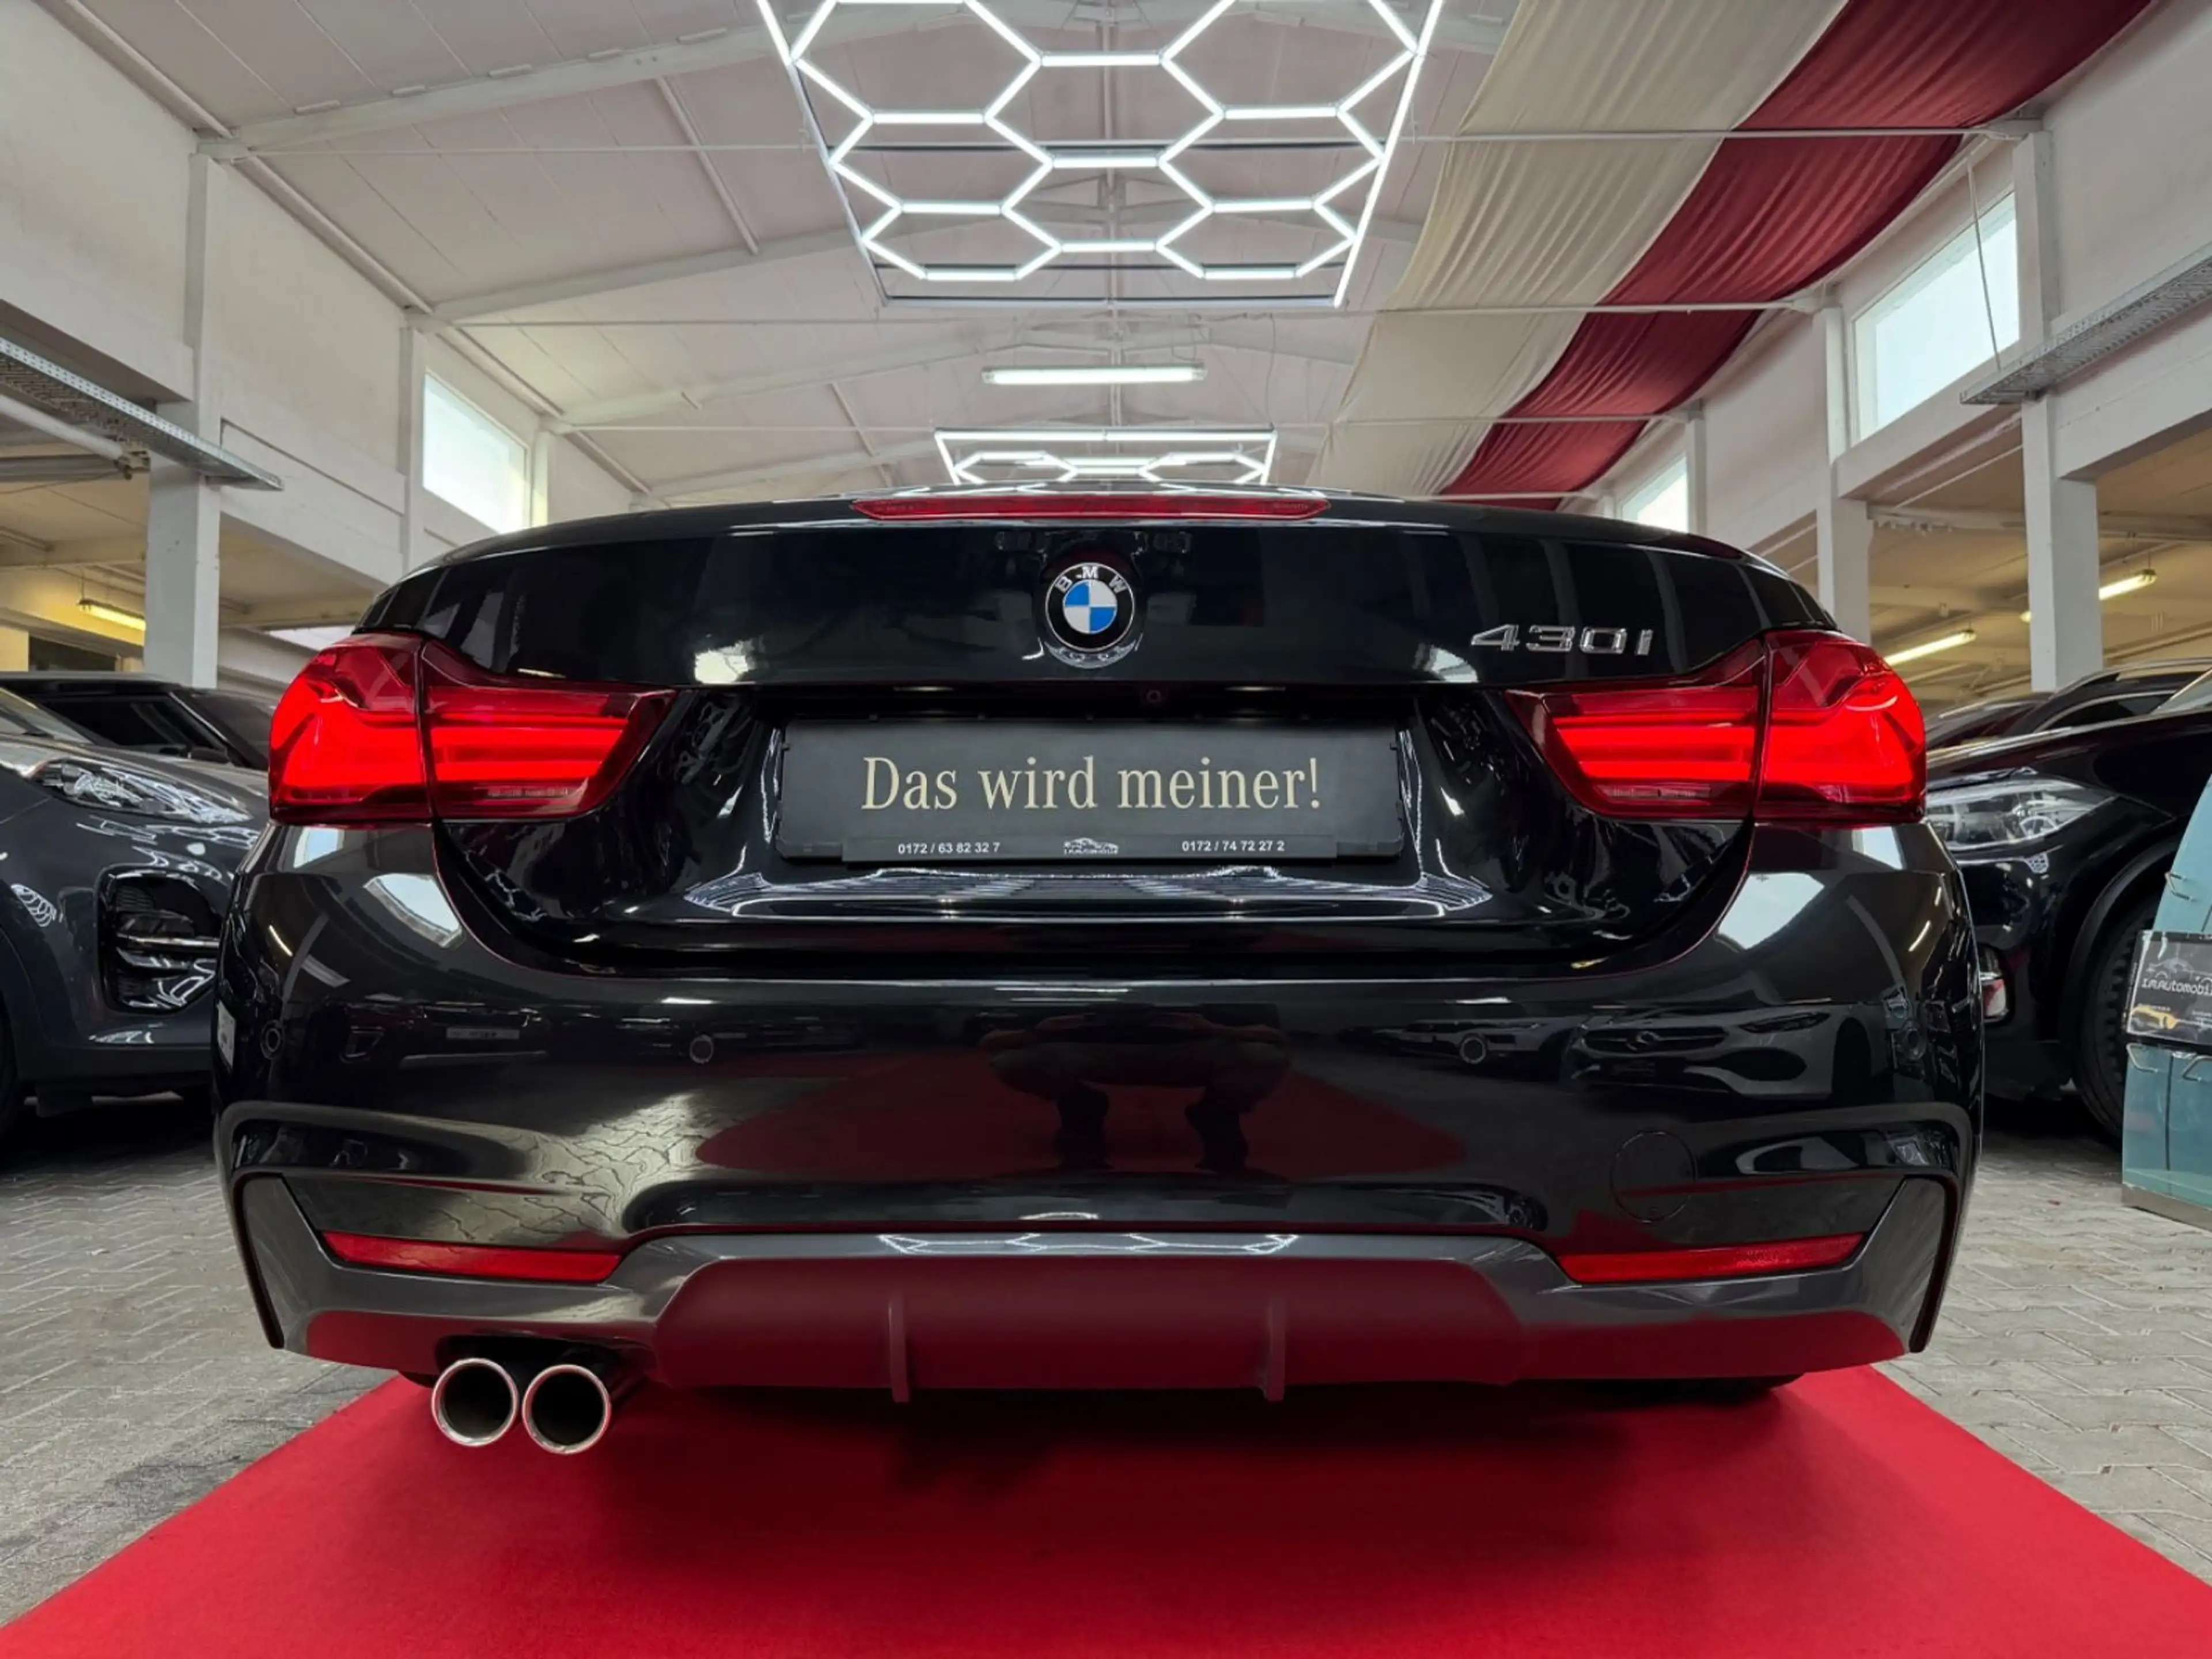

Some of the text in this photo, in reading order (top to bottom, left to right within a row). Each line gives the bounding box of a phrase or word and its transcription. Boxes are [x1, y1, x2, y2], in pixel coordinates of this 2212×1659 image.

[1055, 566, 1128, 593] BMW
[862, 756, 1320, 809] Das wird meiner!
[898, 843, 927, 855] 0172
[993, 842, 1001, 853] 7
[1181, 840, 1211, 852] 0172
[1222, 840, 1237, 853] 74
[1240, 840, 1256, 852] 72
[1258, 840, 1273, 852] 27
[1277, 840, 1285, 851] 2
